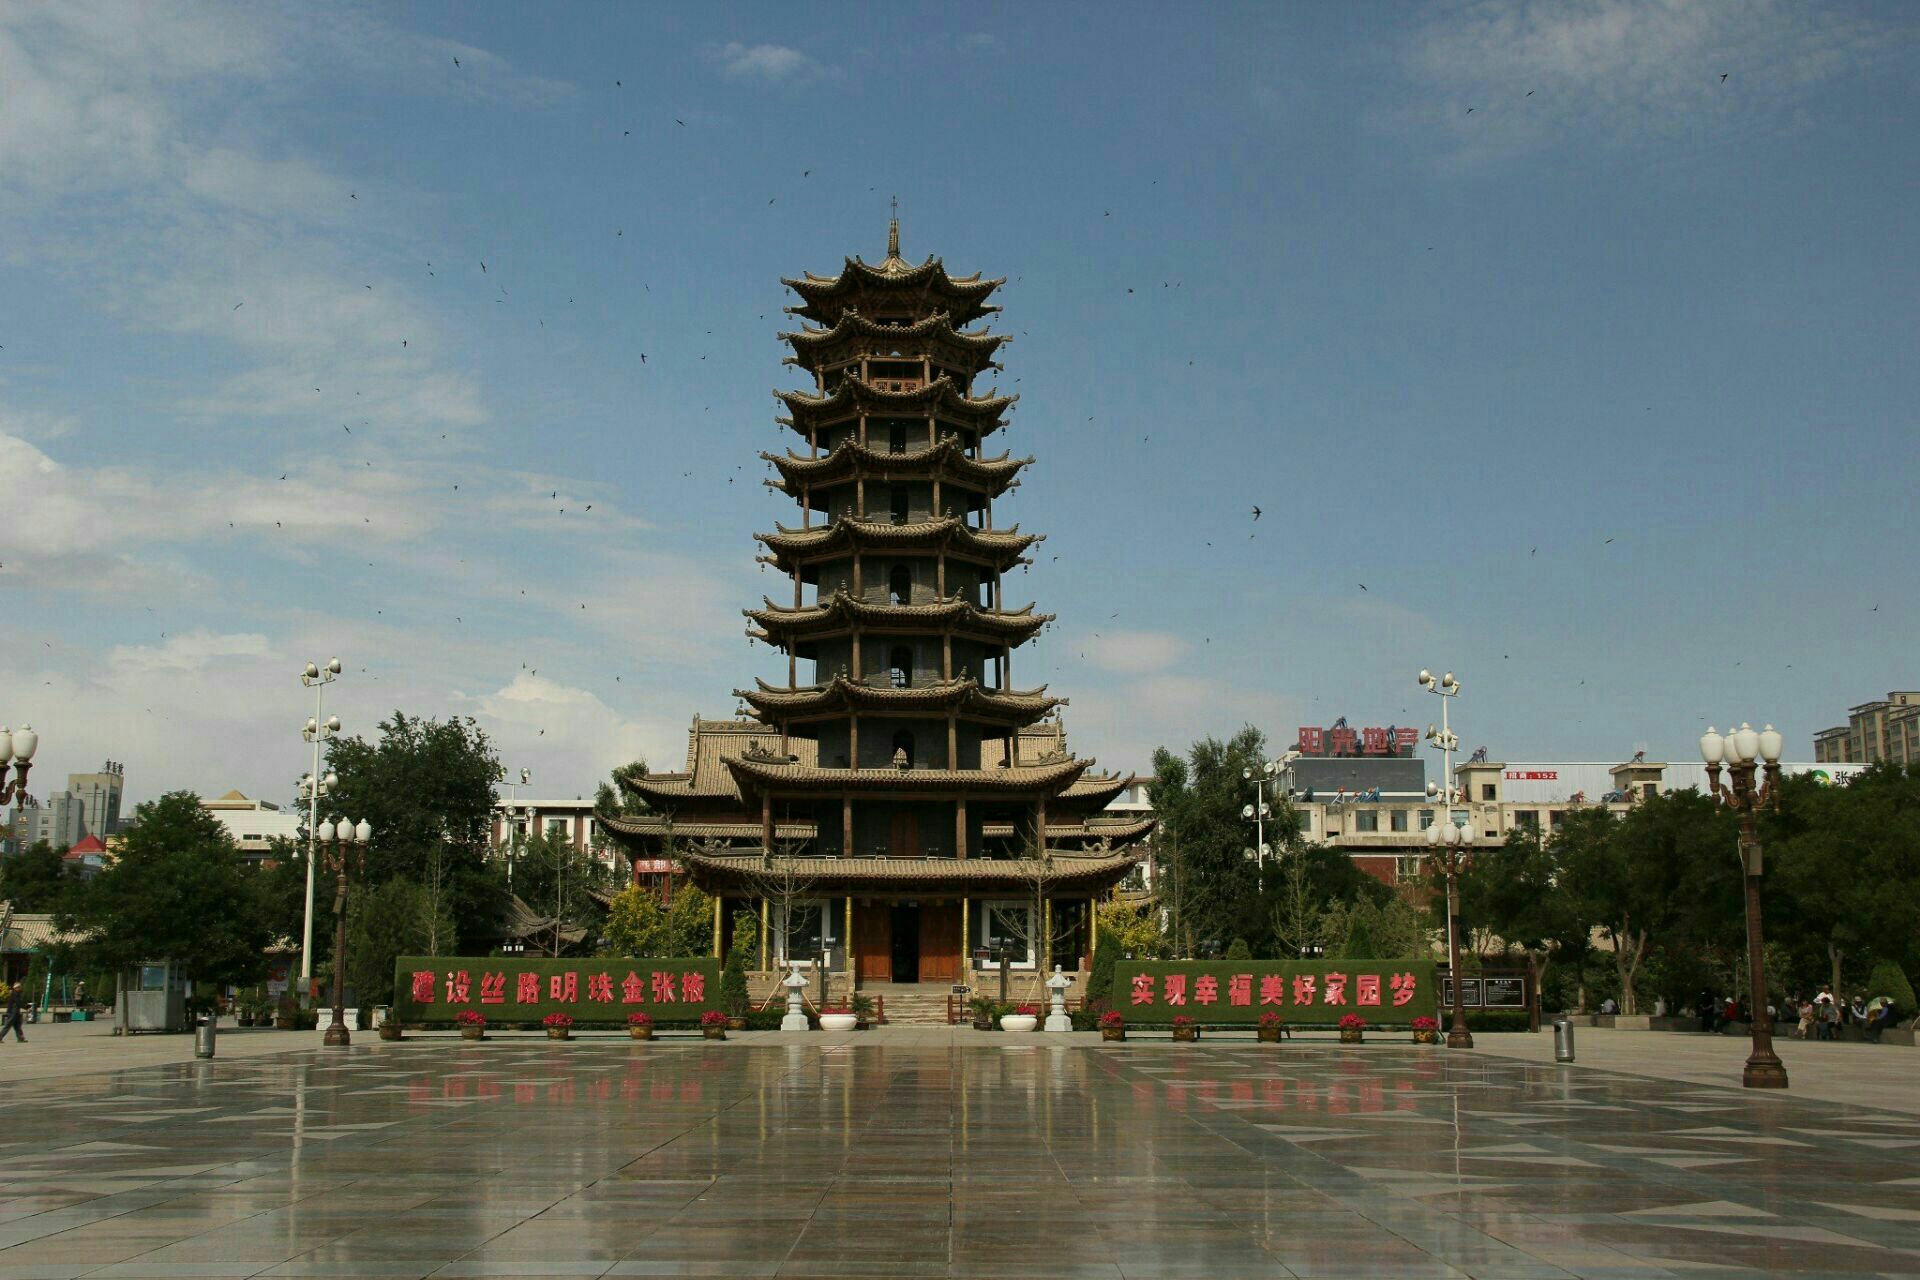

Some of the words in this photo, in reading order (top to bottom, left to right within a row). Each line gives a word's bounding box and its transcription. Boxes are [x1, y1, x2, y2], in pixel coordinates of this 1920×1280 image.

[1298, 727, 1419, 754] 阳光地产
[412, 969, 705, 1004] 建设丝路明珠金张掖
[1131, 971, 1417, 1006] 实现幸福美好家园梦
